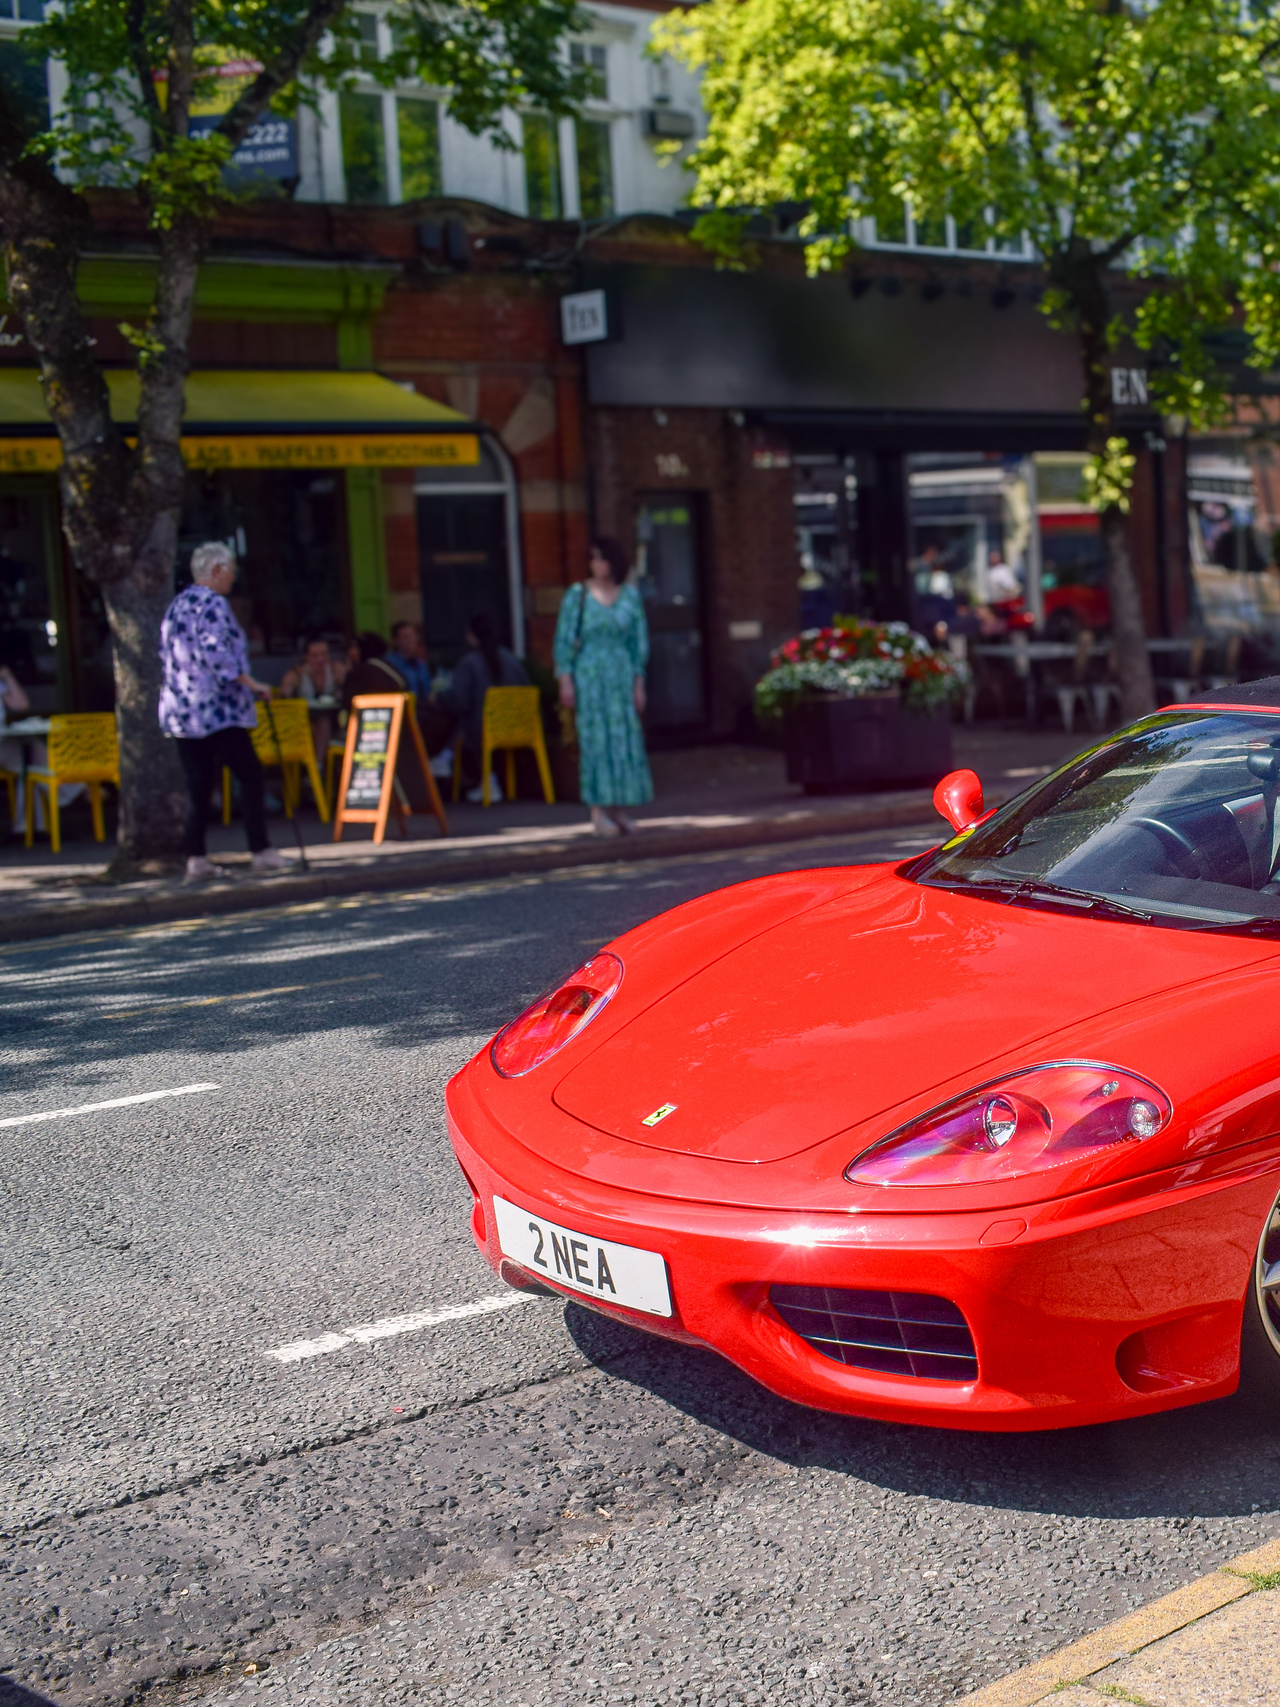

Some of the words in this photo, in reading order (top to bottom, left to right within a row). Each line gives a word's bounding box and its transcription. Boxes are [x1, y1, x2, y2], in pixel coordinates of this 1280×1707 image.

[256, 445, 338, 461] WAFFLES
[361, 443, 458, 459] SMOOTHIES
[528, 1221, 548, 1268] 2
[550, 1231, 617, 1295] NEA
